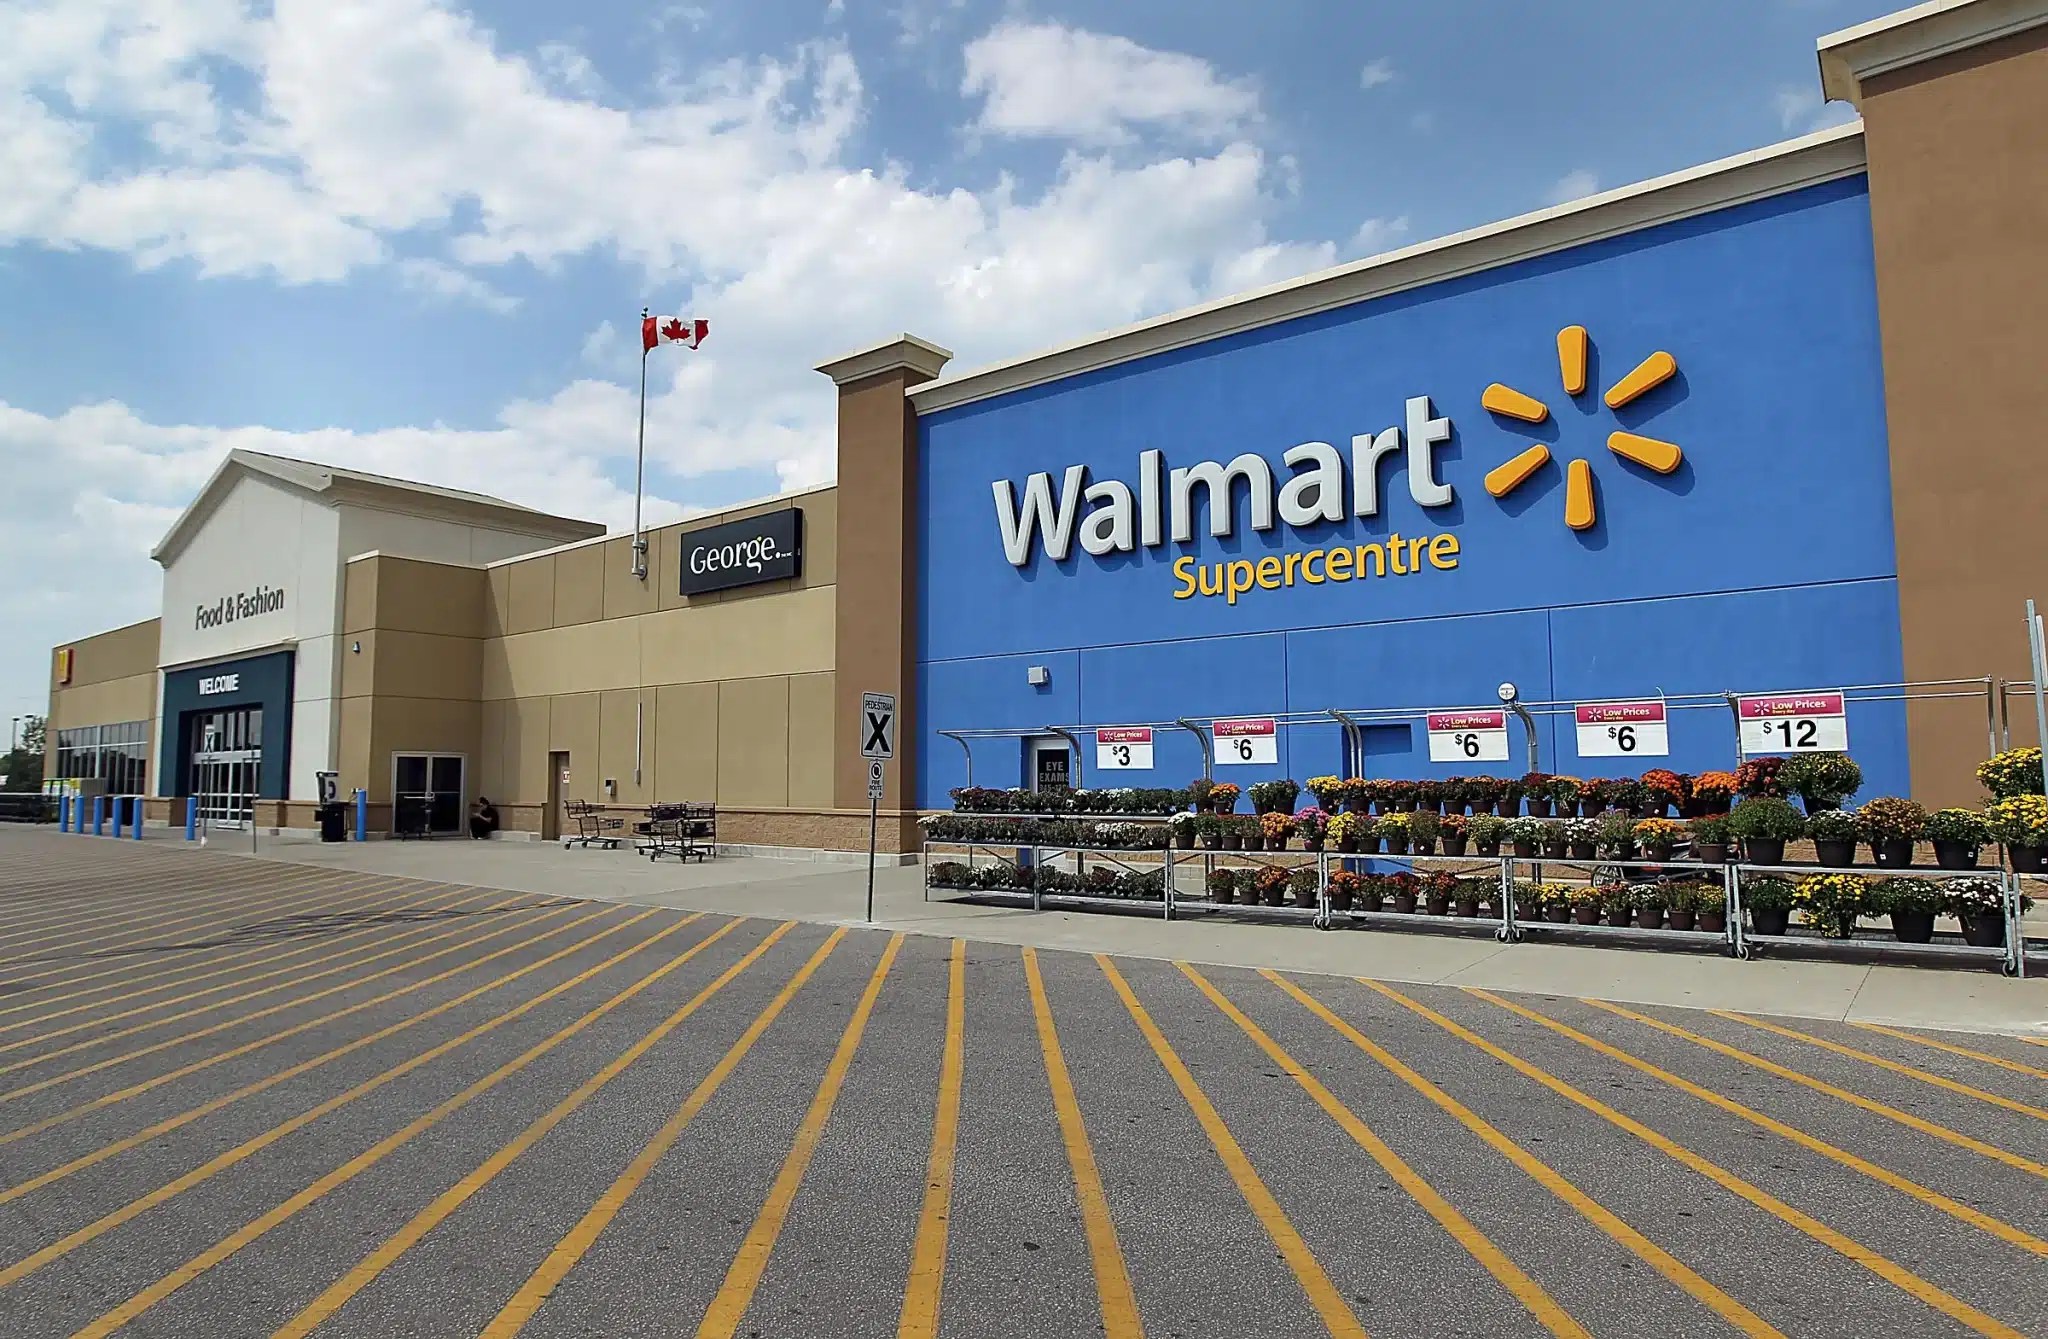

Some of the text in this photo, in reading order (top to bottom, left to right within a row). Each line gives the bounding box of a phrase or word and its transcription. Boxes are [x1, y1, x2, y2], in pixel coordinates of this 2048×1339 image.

[991, 395, 1453, 567] Walmart
[1173, 532, 1460, 604] Supercentre
[195, 585, 284, 631] Food & Fashion
[199, 673, 239, 695] WELCOME
[865, 700, 893, 711] PEDESTRIAN
[1603, 707, 1650, 717] Low Prices
[1772, 699, 1827, 710] Low Prices
[1245, 723, 1265, 731] Prices
[1451, 716, 1491, 725] Low Prices
[864, 711, 892, 753] X
[1126, 730, 1143, 738] Prices
[1608, 726, 1636, 752] $6
[1112, 745, 1131, 766] $3
[1233, 739, 1253, 761] $6
[1455, 733, 1480, 757] $6
[1046, 761, 1064, 771] EYE
[1039, 772, 1069, 782] EXAMS
